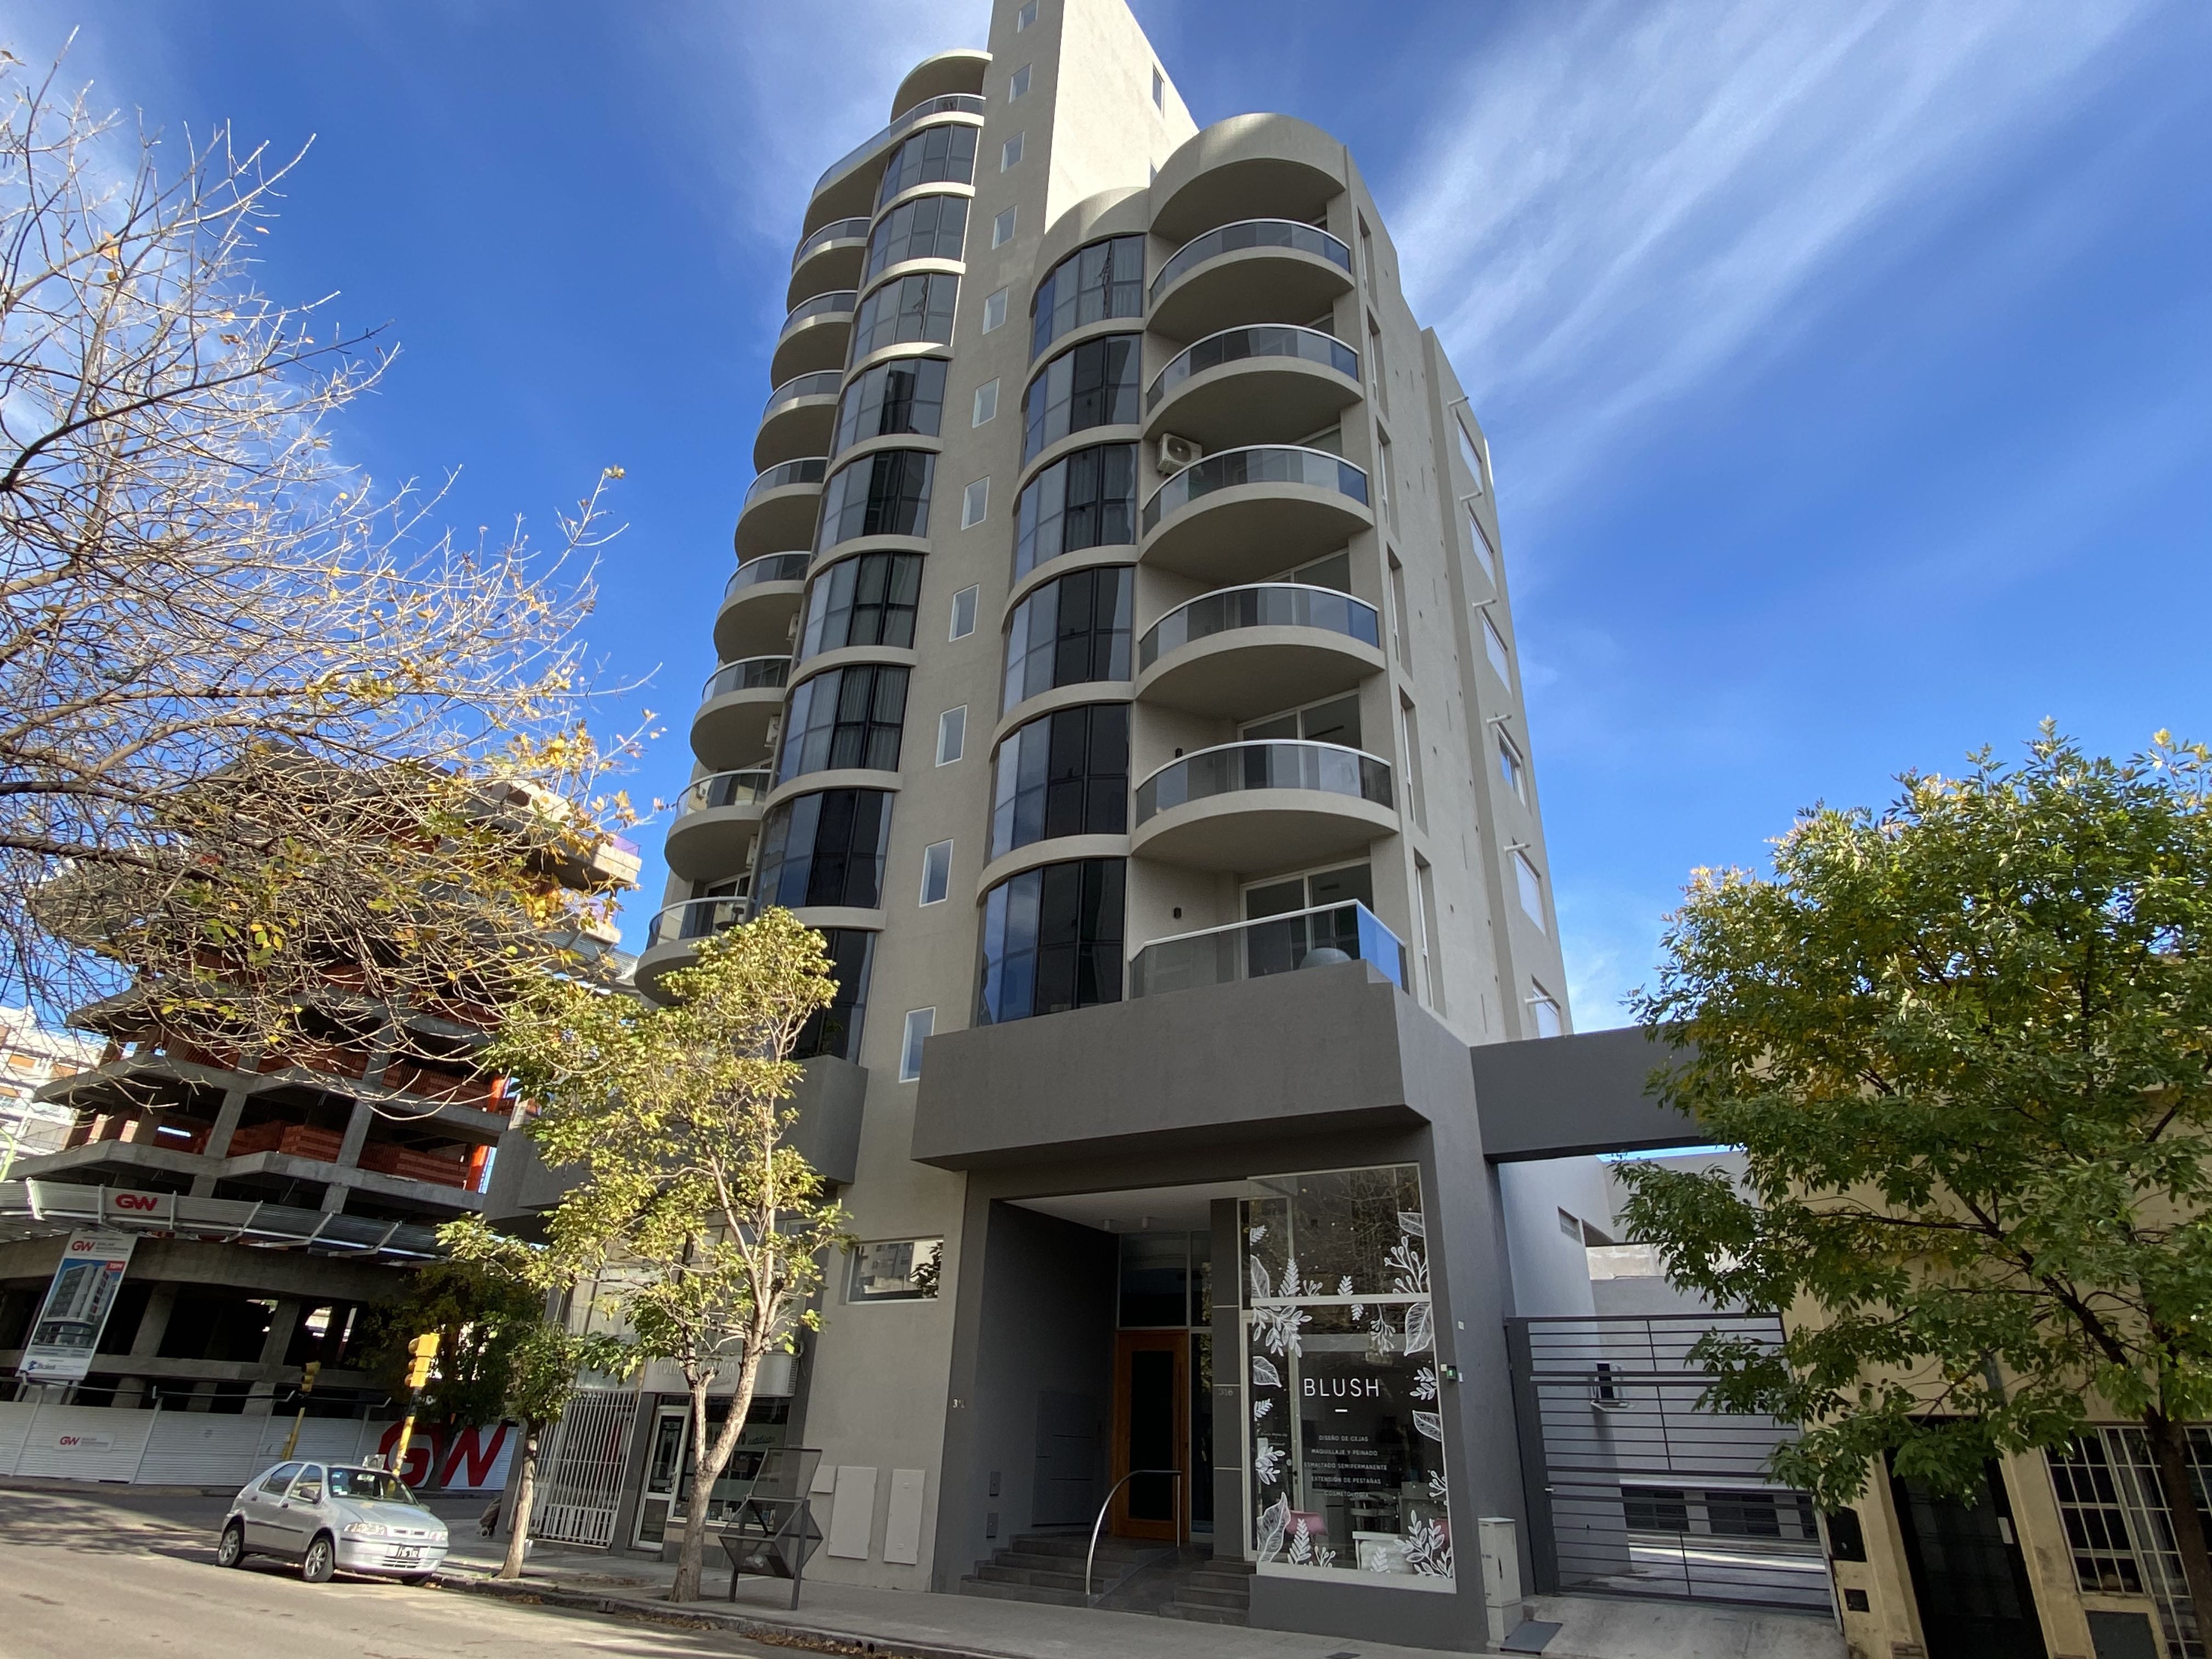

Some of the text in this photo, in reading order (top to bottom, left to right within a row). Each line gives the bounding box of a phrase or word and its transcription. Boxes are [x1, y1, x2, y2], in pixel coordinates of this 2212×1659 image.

[115, 1193, 157, 1211] GW
[72, 1240, 96, 1251] GW
[1304, 1378, 1379, 1397] BLUSH
[60, 1436, 81, 1446] GW
[1338, 1463, 1387, 1471] SEMIPERMANENTE
